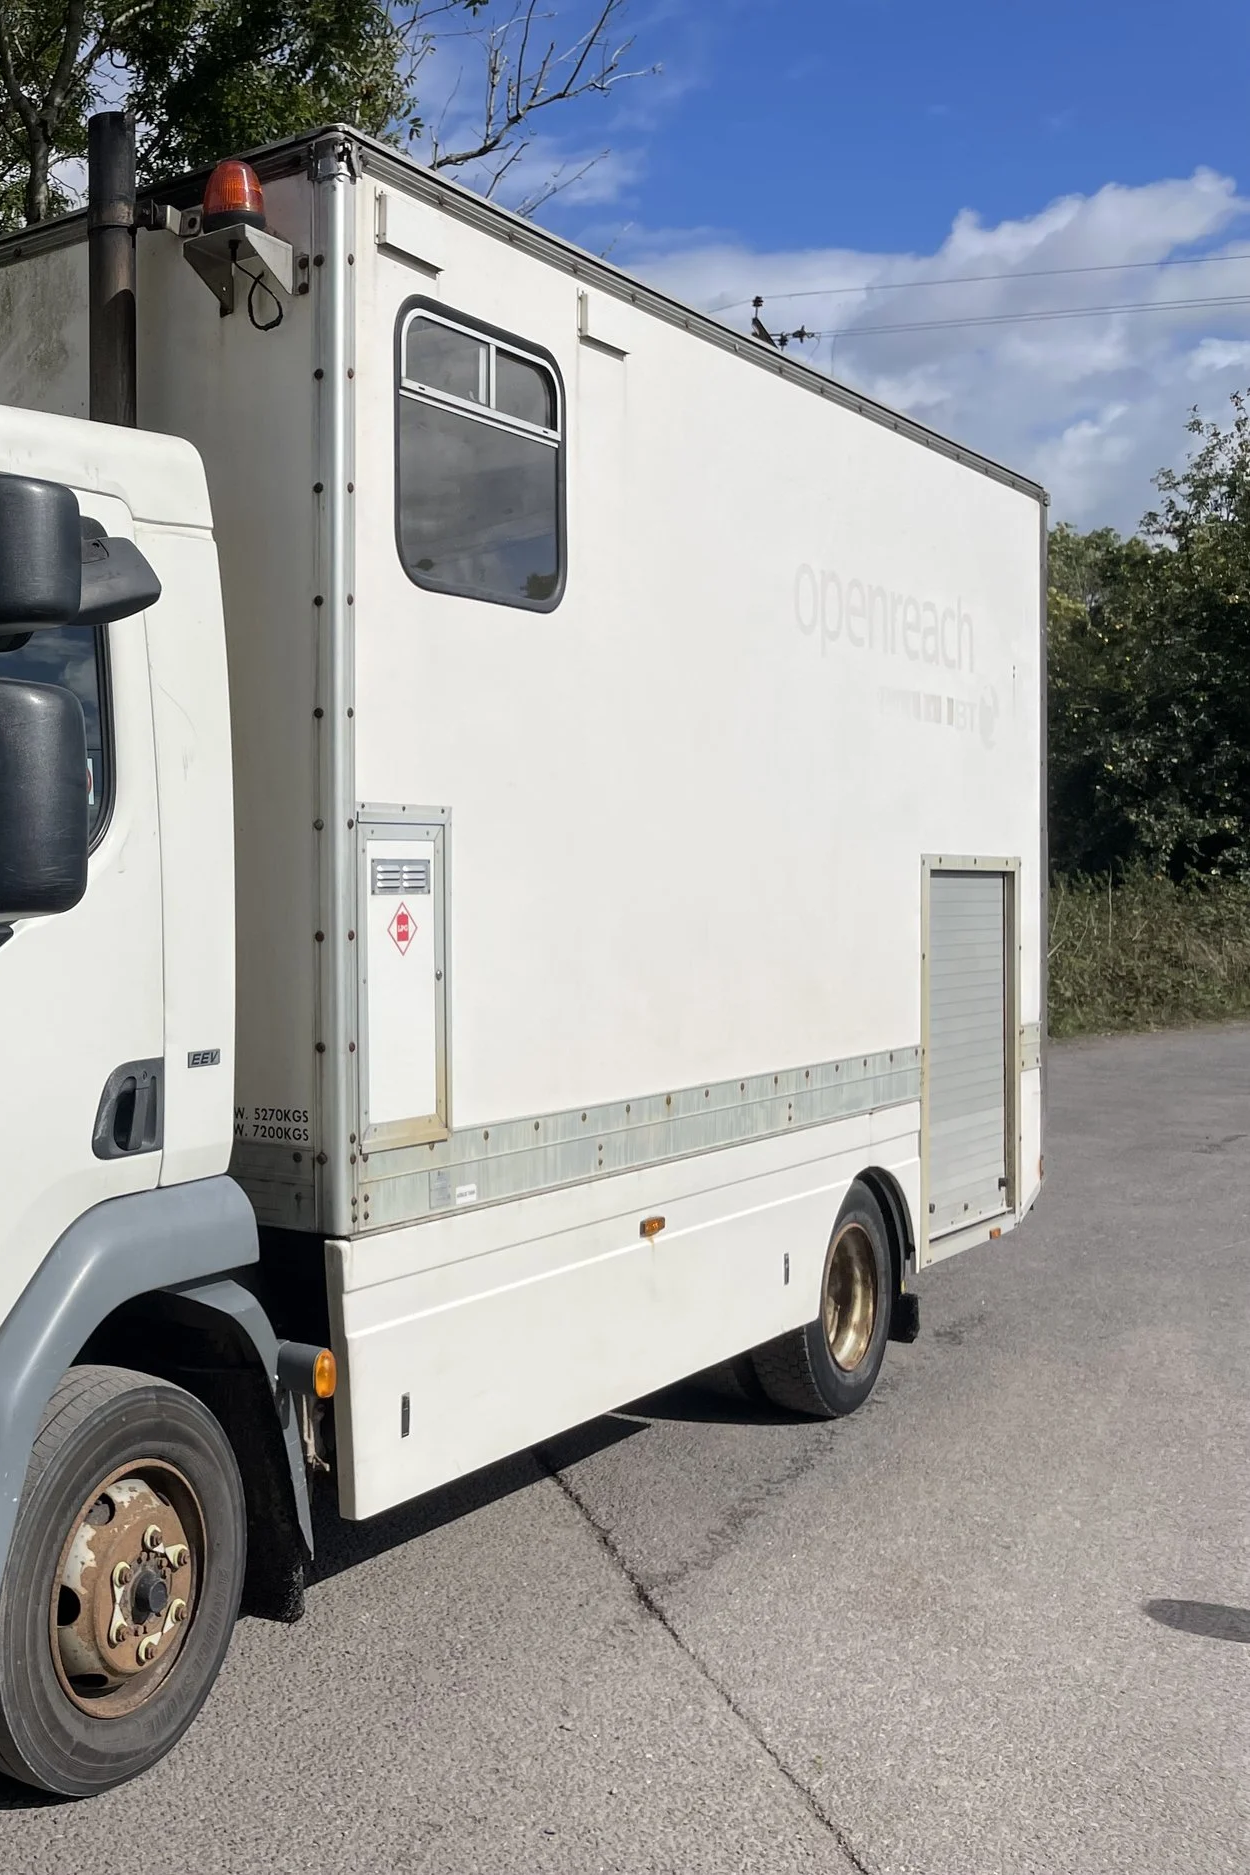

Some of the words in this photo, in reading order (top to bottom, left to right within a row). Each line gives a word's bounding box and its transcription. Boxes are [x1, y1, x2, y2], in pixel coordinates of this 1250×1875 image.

[793, 562, 975, 674] openreach
[190, 1050, 219, 1066] EEV
[254, 1108, 309, 1123] 5270KGS
[252, 1124, 309, 1141] 7200KGS
